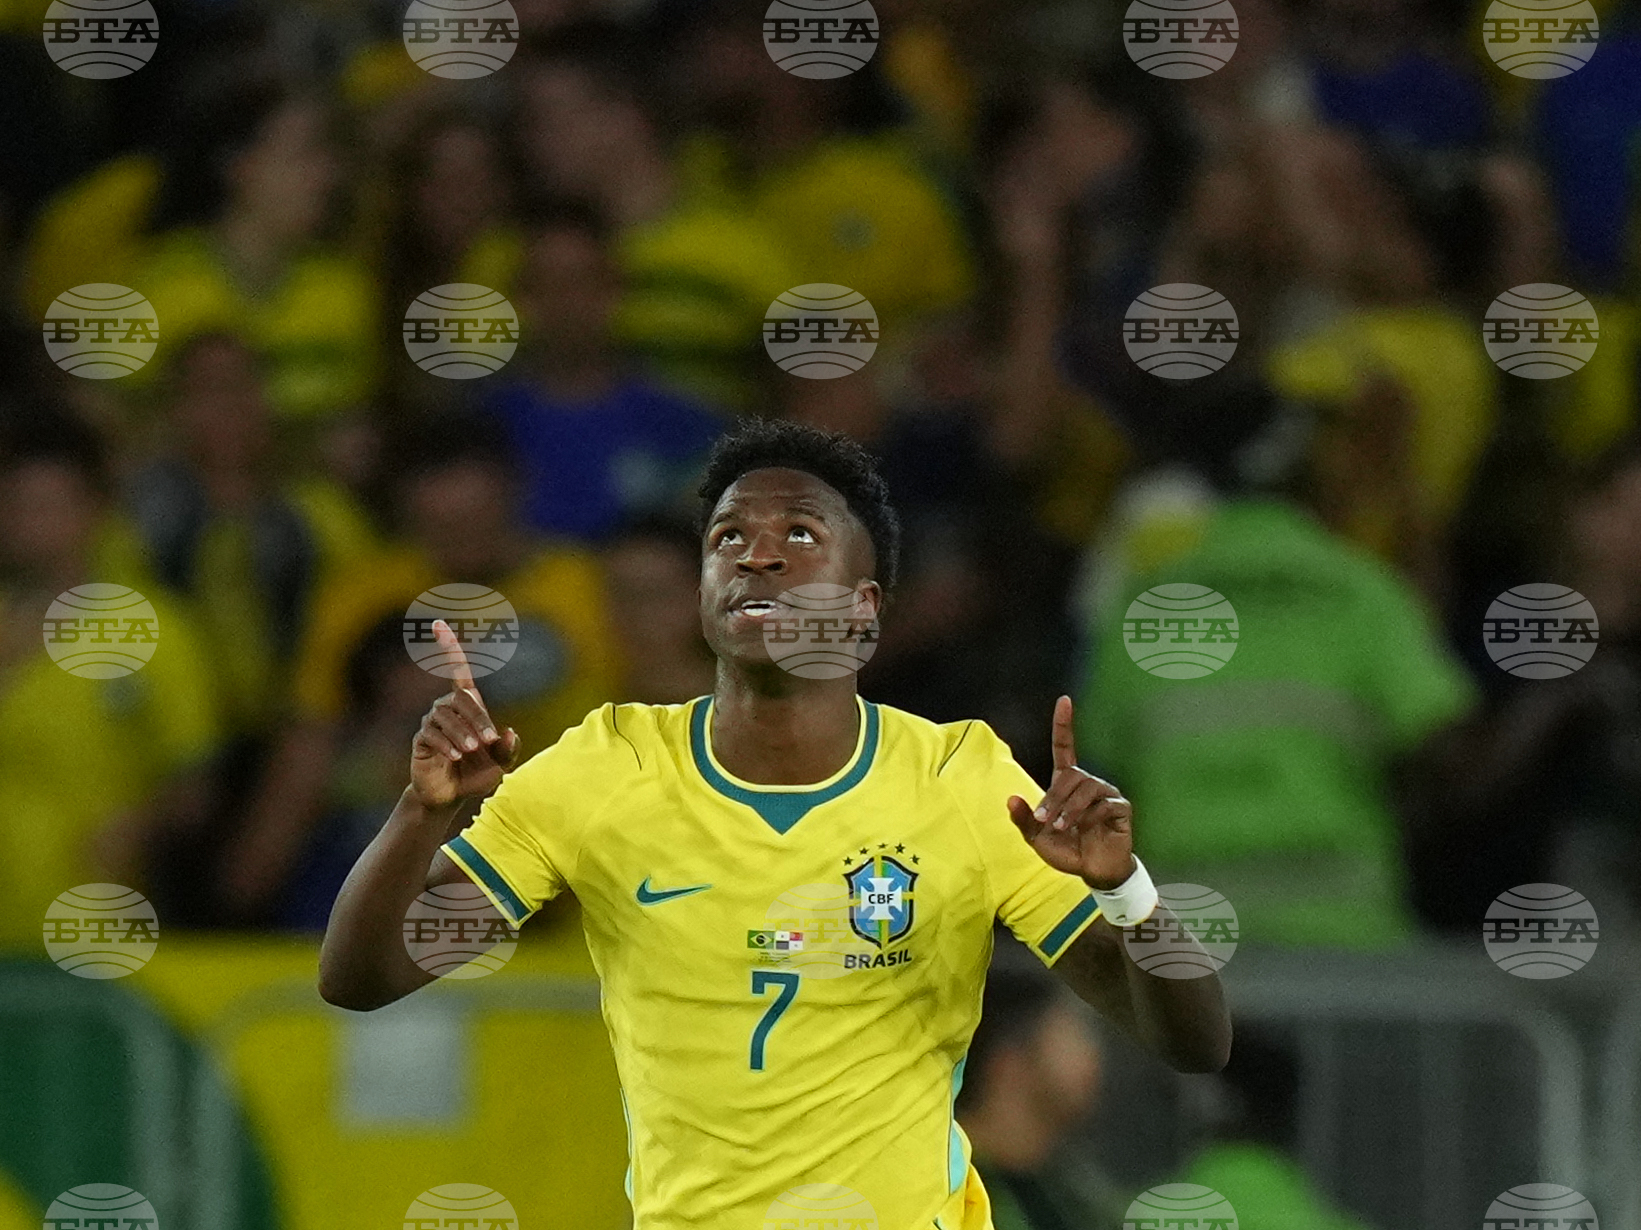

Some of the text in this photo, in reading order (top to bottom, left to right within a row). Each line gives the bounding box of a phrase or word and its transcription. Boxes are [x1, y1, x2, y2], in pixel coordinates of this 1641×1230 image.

[868, 893, 895, 905] CBF
[844, 949, 913, 969] BRASIL
[750, 971, 800, 1072] 7
